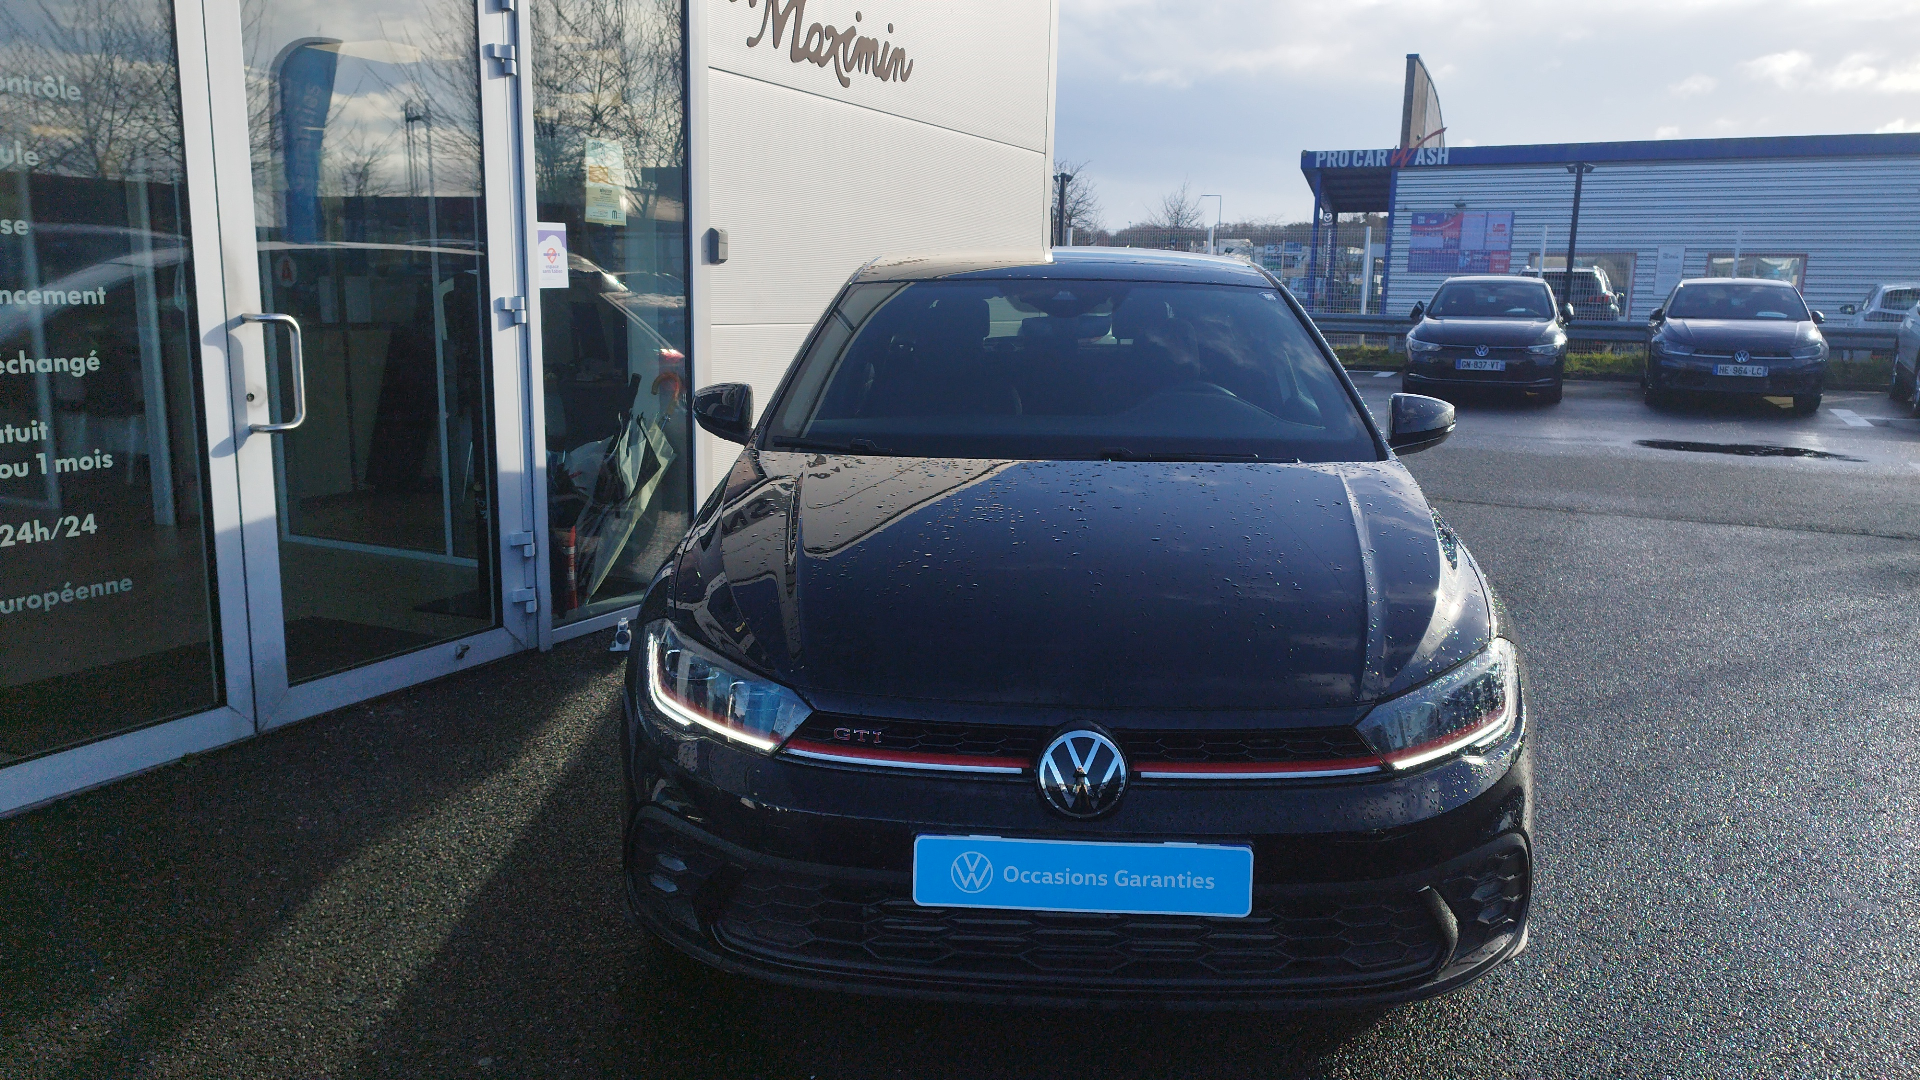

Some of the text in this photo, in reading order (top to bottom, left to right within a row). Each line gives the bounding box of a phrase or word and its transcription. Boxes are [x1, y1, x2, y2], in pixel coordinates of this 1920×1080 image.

[1315, 150, 1349, 168] PRO
[1353, 149, 1388, 167] CAR
[0, 448, 114, 479] ou 1 mois
[0, 513, 98, 547] 24h/24
[833, 727, 882, 744] GTI
[1003, 865, 1108, 887] Occasions
[1114, 869, 1216, 890] Garanties
